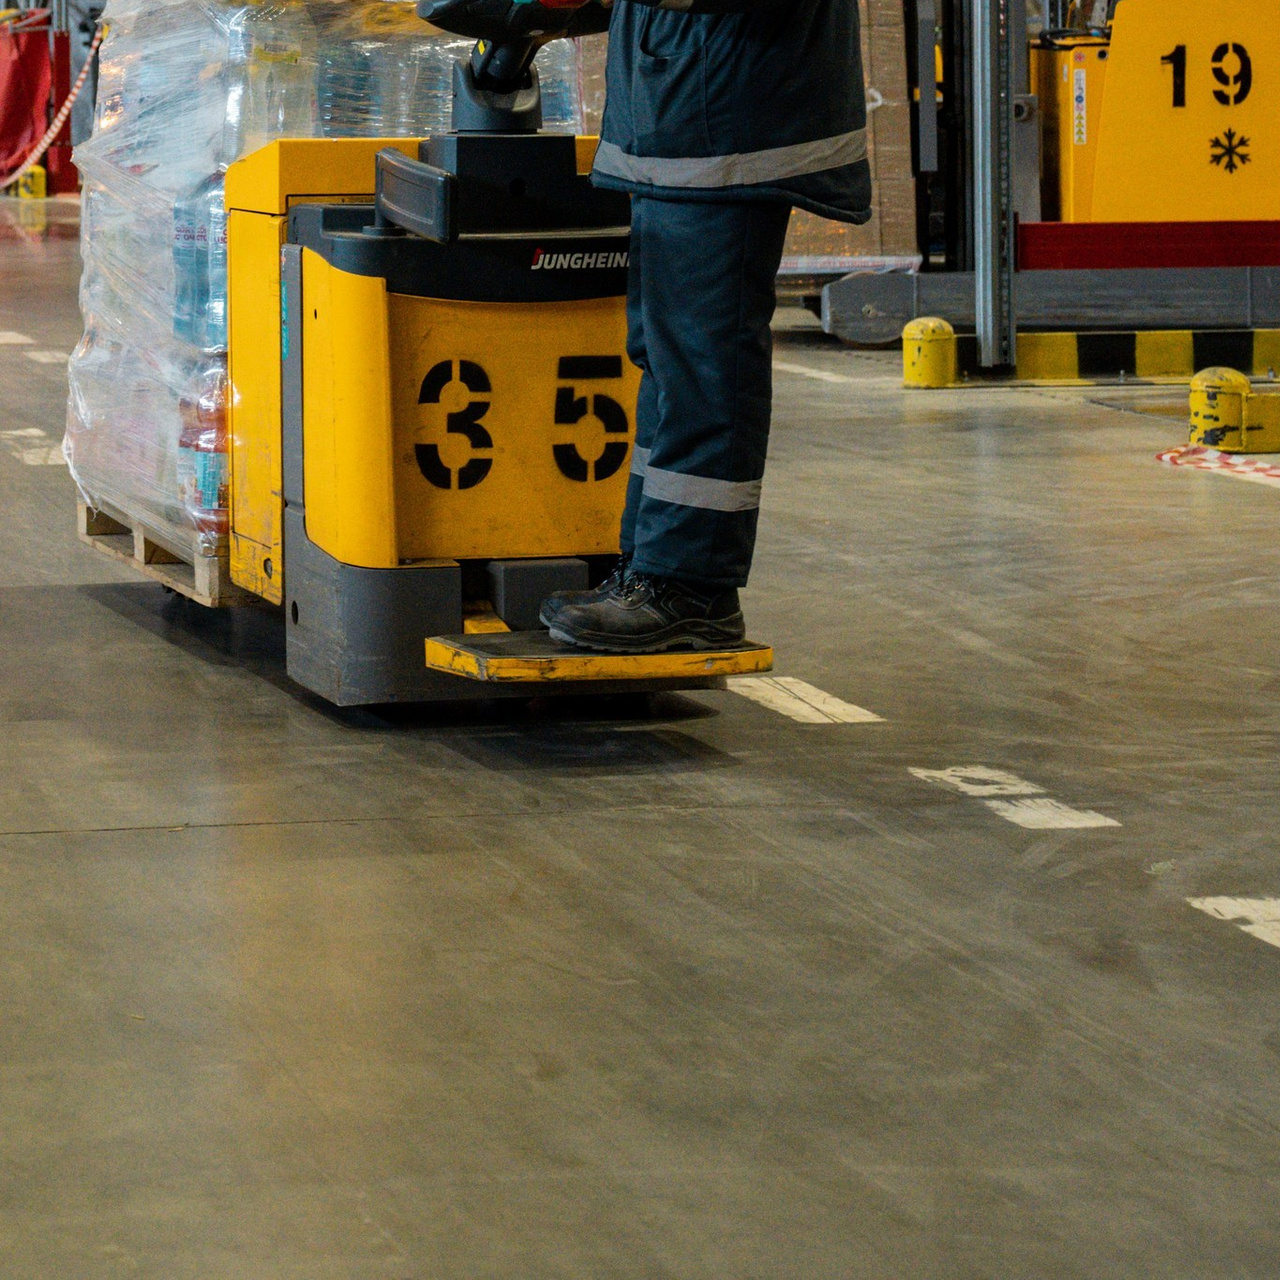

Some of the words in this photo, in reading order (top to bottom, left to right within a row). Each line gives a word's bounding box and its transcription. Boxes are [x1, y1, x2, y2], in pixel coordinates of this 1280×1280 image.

[1160, 42, 1252, 108] 19
[531, 248, 631, 270] JUNGHEIN
[414, 355, 629, 490] 35
